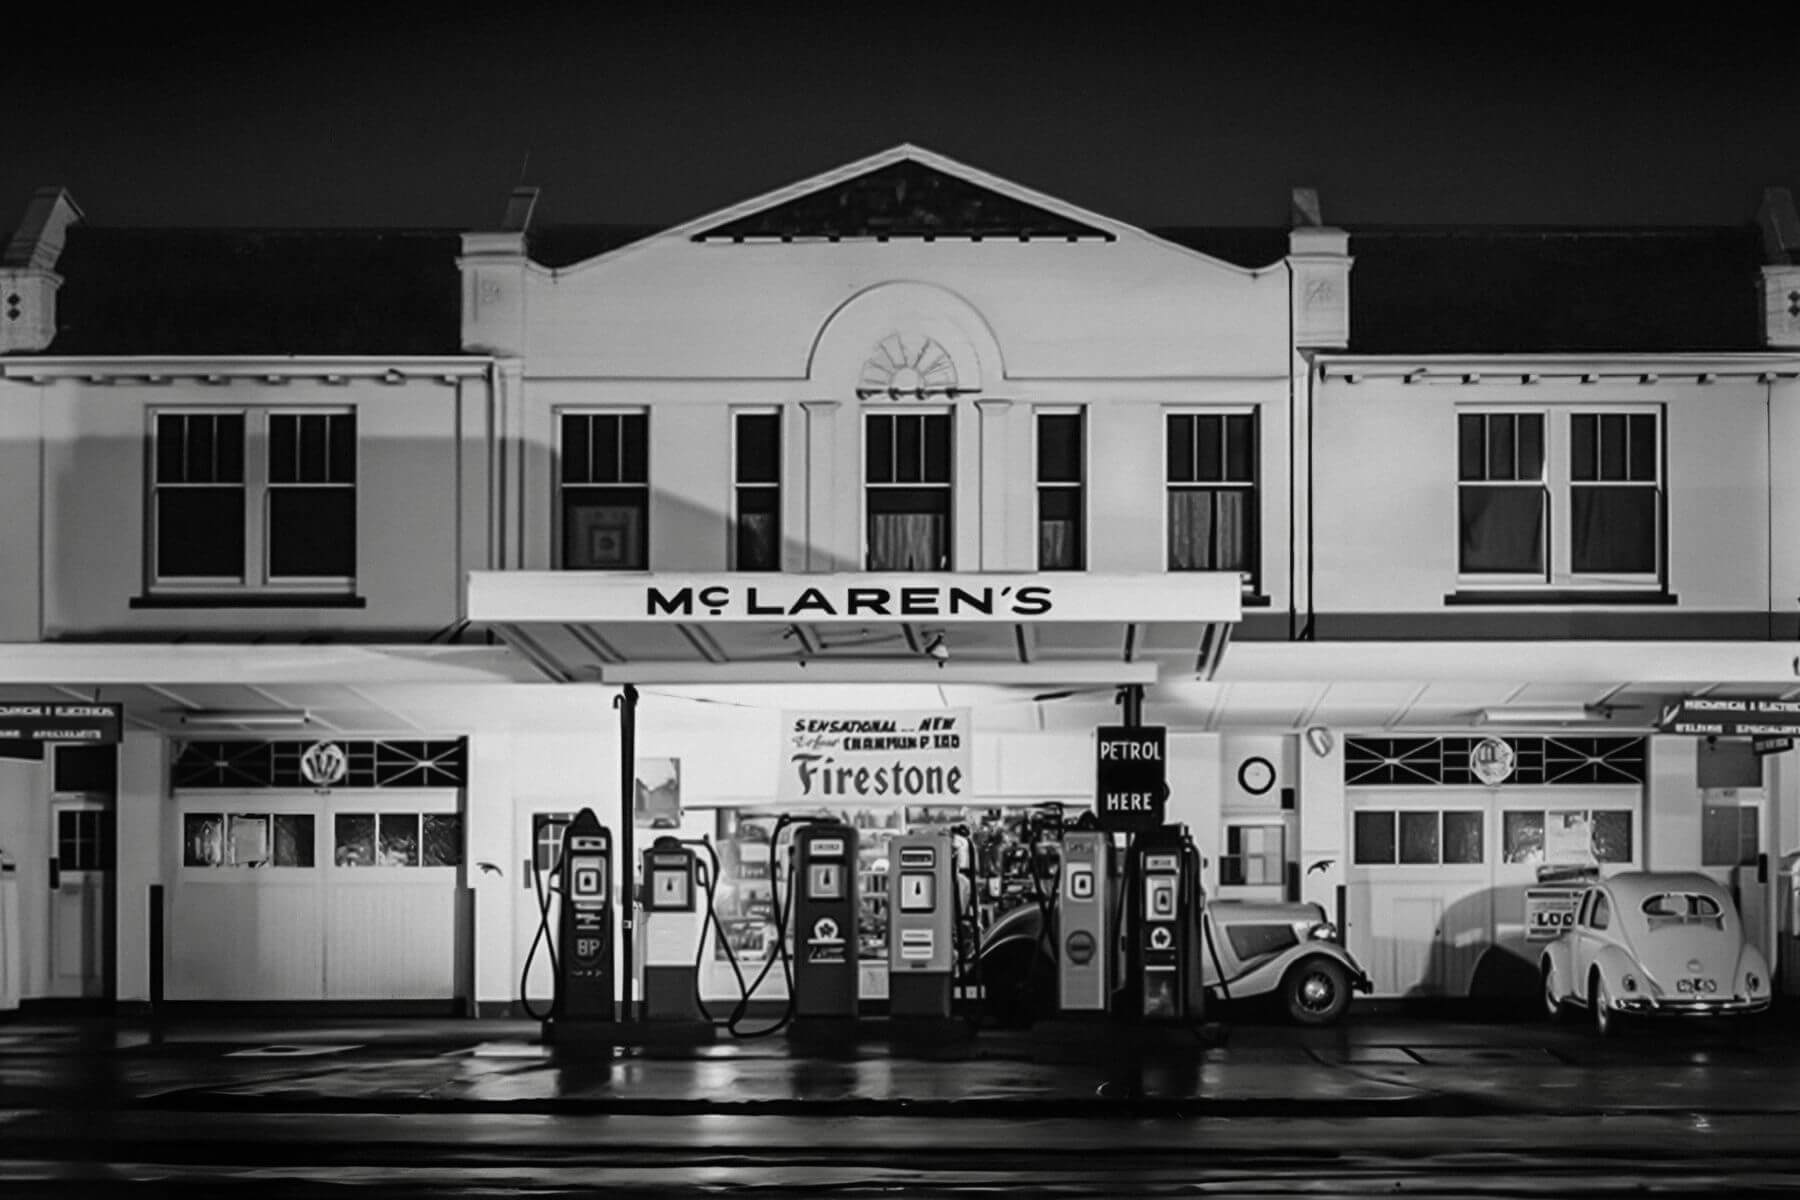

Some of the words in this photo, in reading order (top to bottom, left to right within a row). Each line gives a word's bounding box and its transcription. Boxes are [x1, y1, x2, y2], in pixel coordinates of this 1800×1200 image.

[794, 718, 897, 733] SENSATIONAL
[919, 717, 956, 731] NEW
[1101, 741, 1162, 760] PETROL
[791, 753, 962, 796] Firestone
[1107, 792, 1152, 811] HERE
[578, 939, 600, 956] BP
